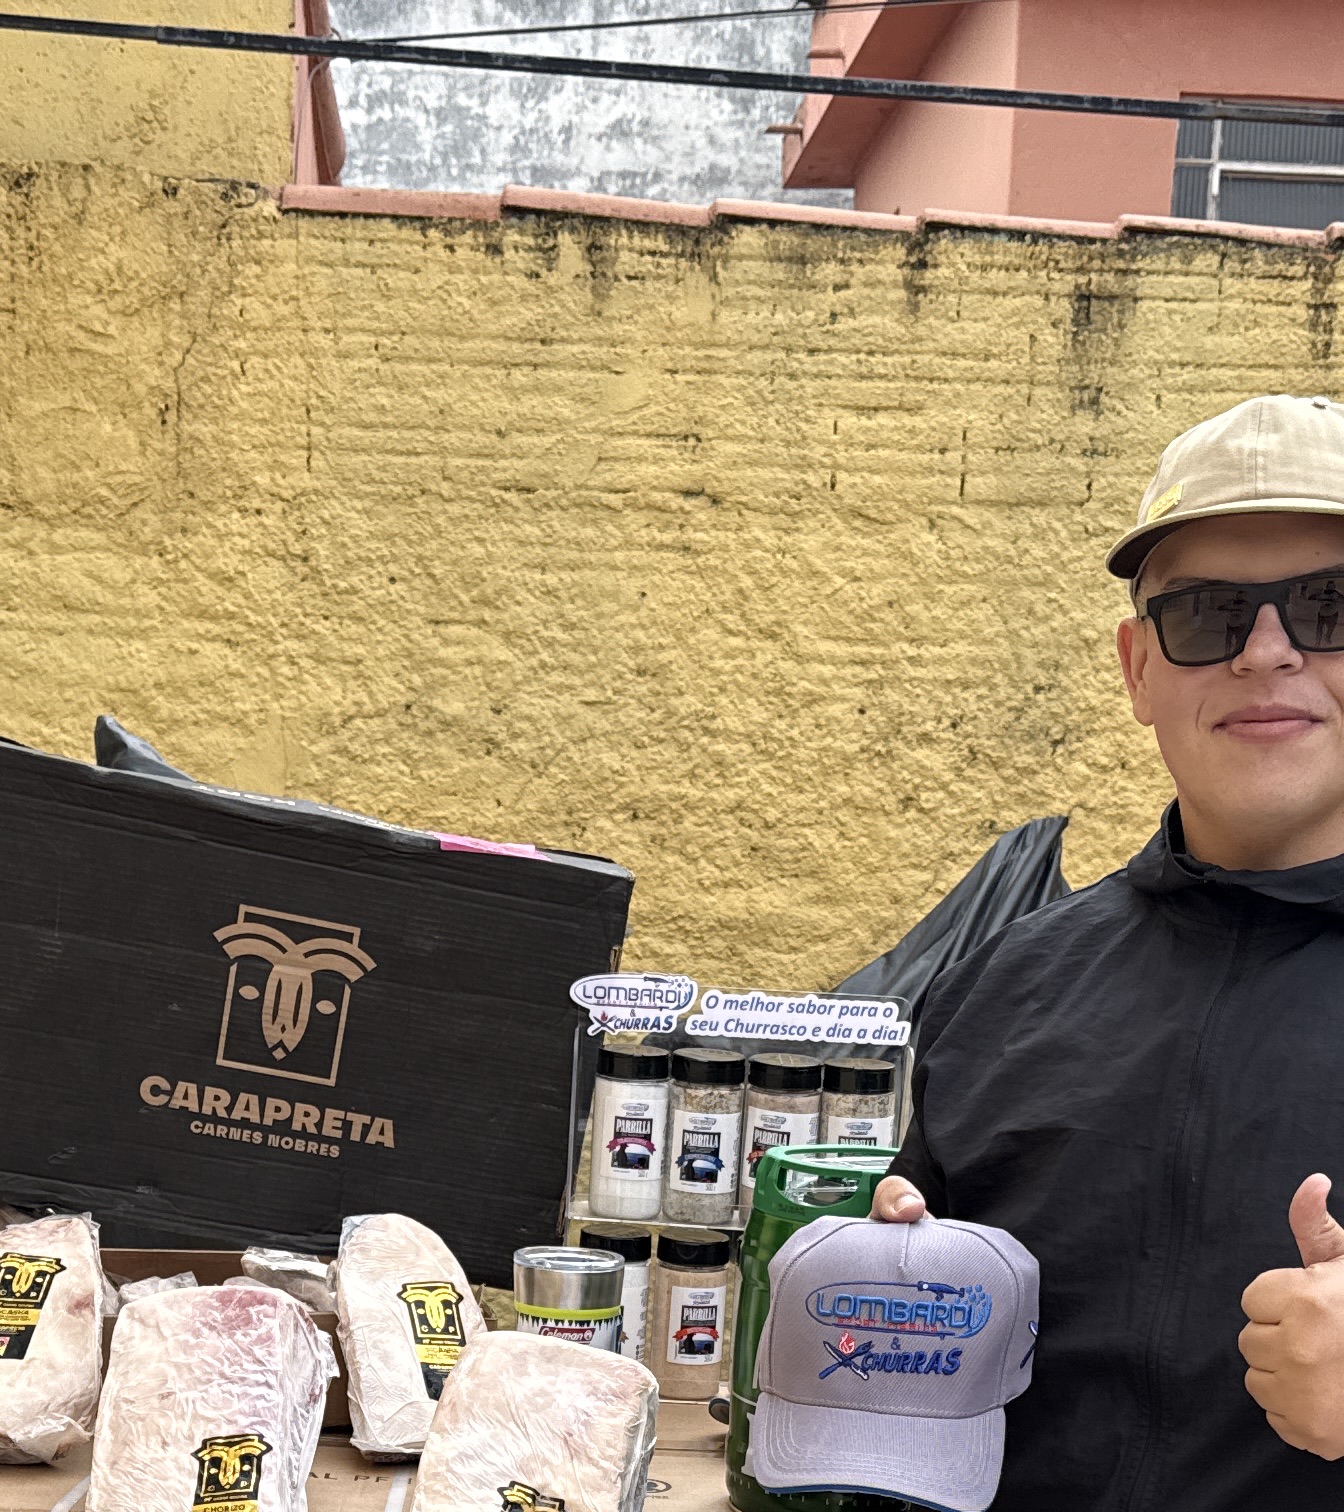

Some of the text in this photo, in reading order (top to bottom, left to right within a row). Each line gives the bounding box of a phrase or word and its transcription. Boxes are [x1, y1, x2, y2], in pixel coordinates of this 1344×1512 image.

[582, 984, 682, 1005] LOMBARDI
[705, 995, 893, 1019] O melhor sabor para o
[613, 1014, 674, 1031] CHURRAS
[690, 1018, 906, 1041] seu Churrasco e dia a dia!
[139, 1075, 395, 1148] CARAPRETA
[190, 1120, 340, 1158] CARNES NOBRES
[816, 1292, 977, 1330] LOMBARDI
[891, 1336, 901, 1350] &
[861, 1347, 963, 1376] CHURRAS
